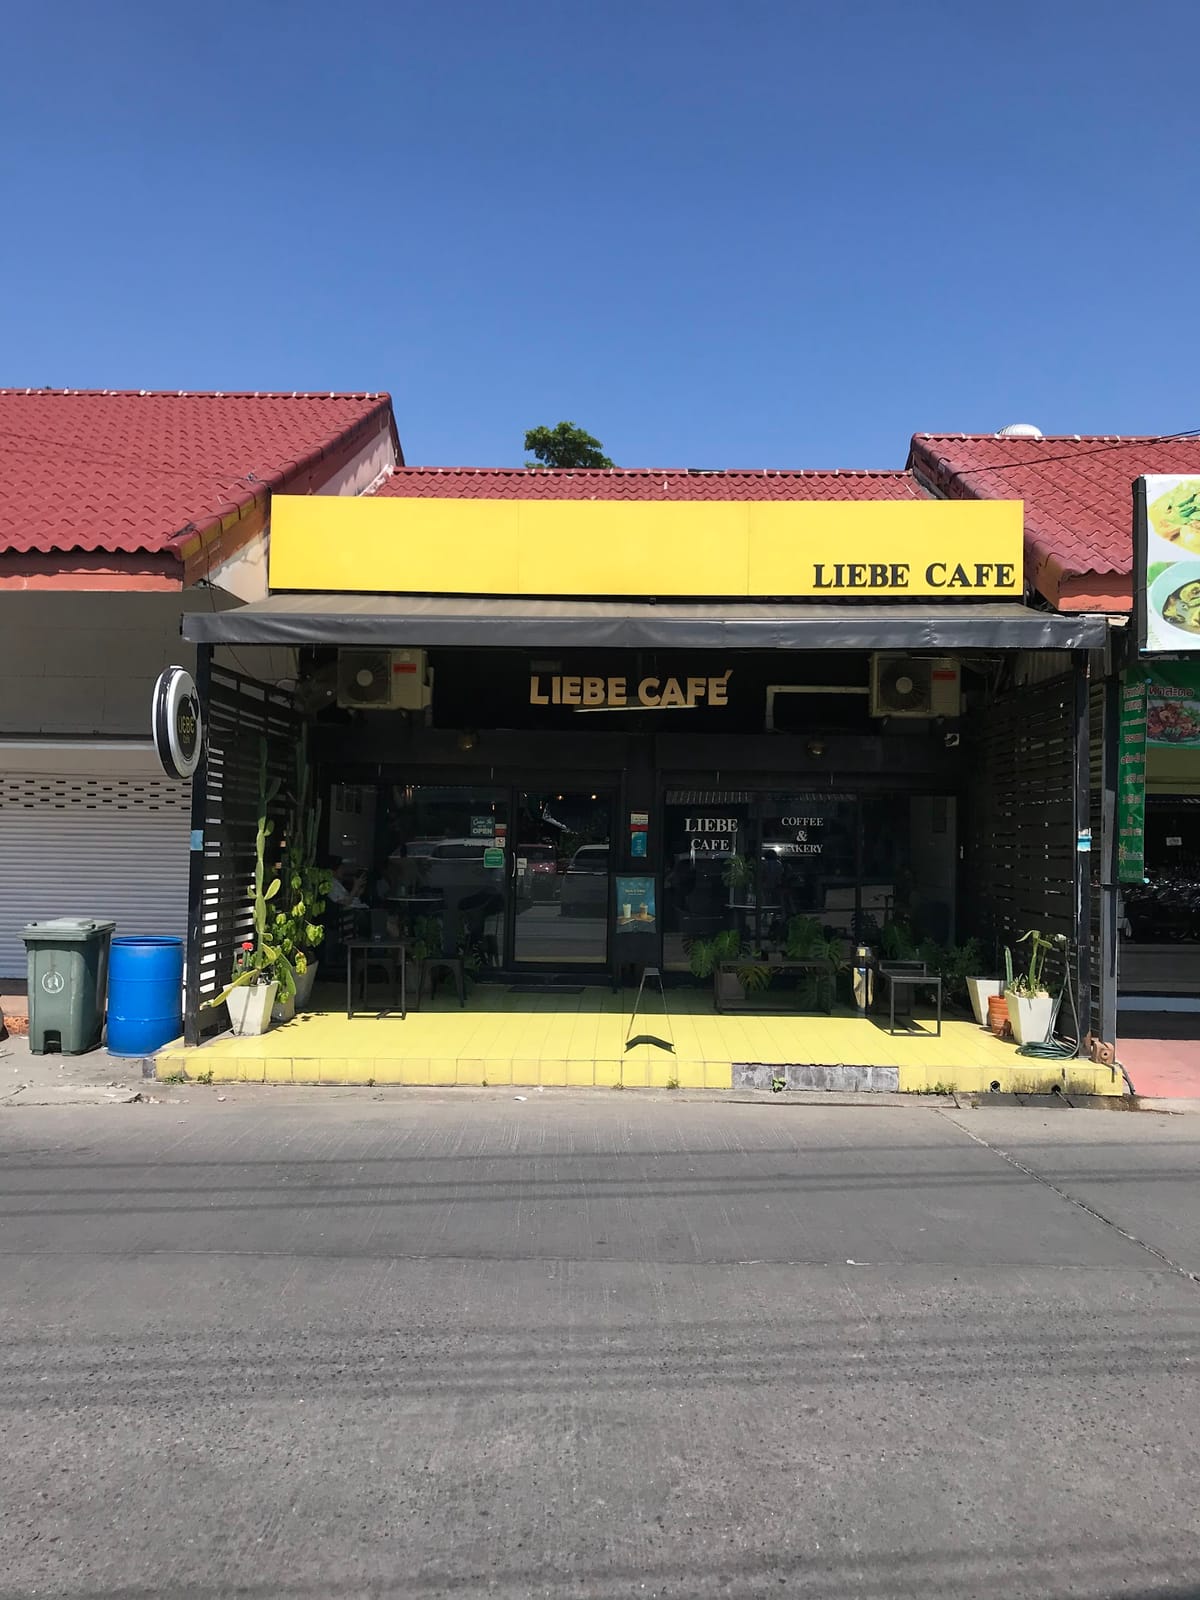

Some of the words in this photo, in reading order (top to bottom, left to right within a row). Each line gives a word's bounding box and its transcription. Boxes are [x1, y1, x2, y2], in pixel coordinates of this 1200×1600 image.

[813, 564, 910, 588] LIEBE
[925, 563, 1015, 588] CAFE
[529, 675, 627, 705] LIEBE
[637, 669, 734, 706] CAFÉ
[684, 818, 738, 832] LIEBE
[781, 816, 824, 827] COFFEE
[796, 829, 808, 842] &
[690, 838, 729, 851] CAFE
